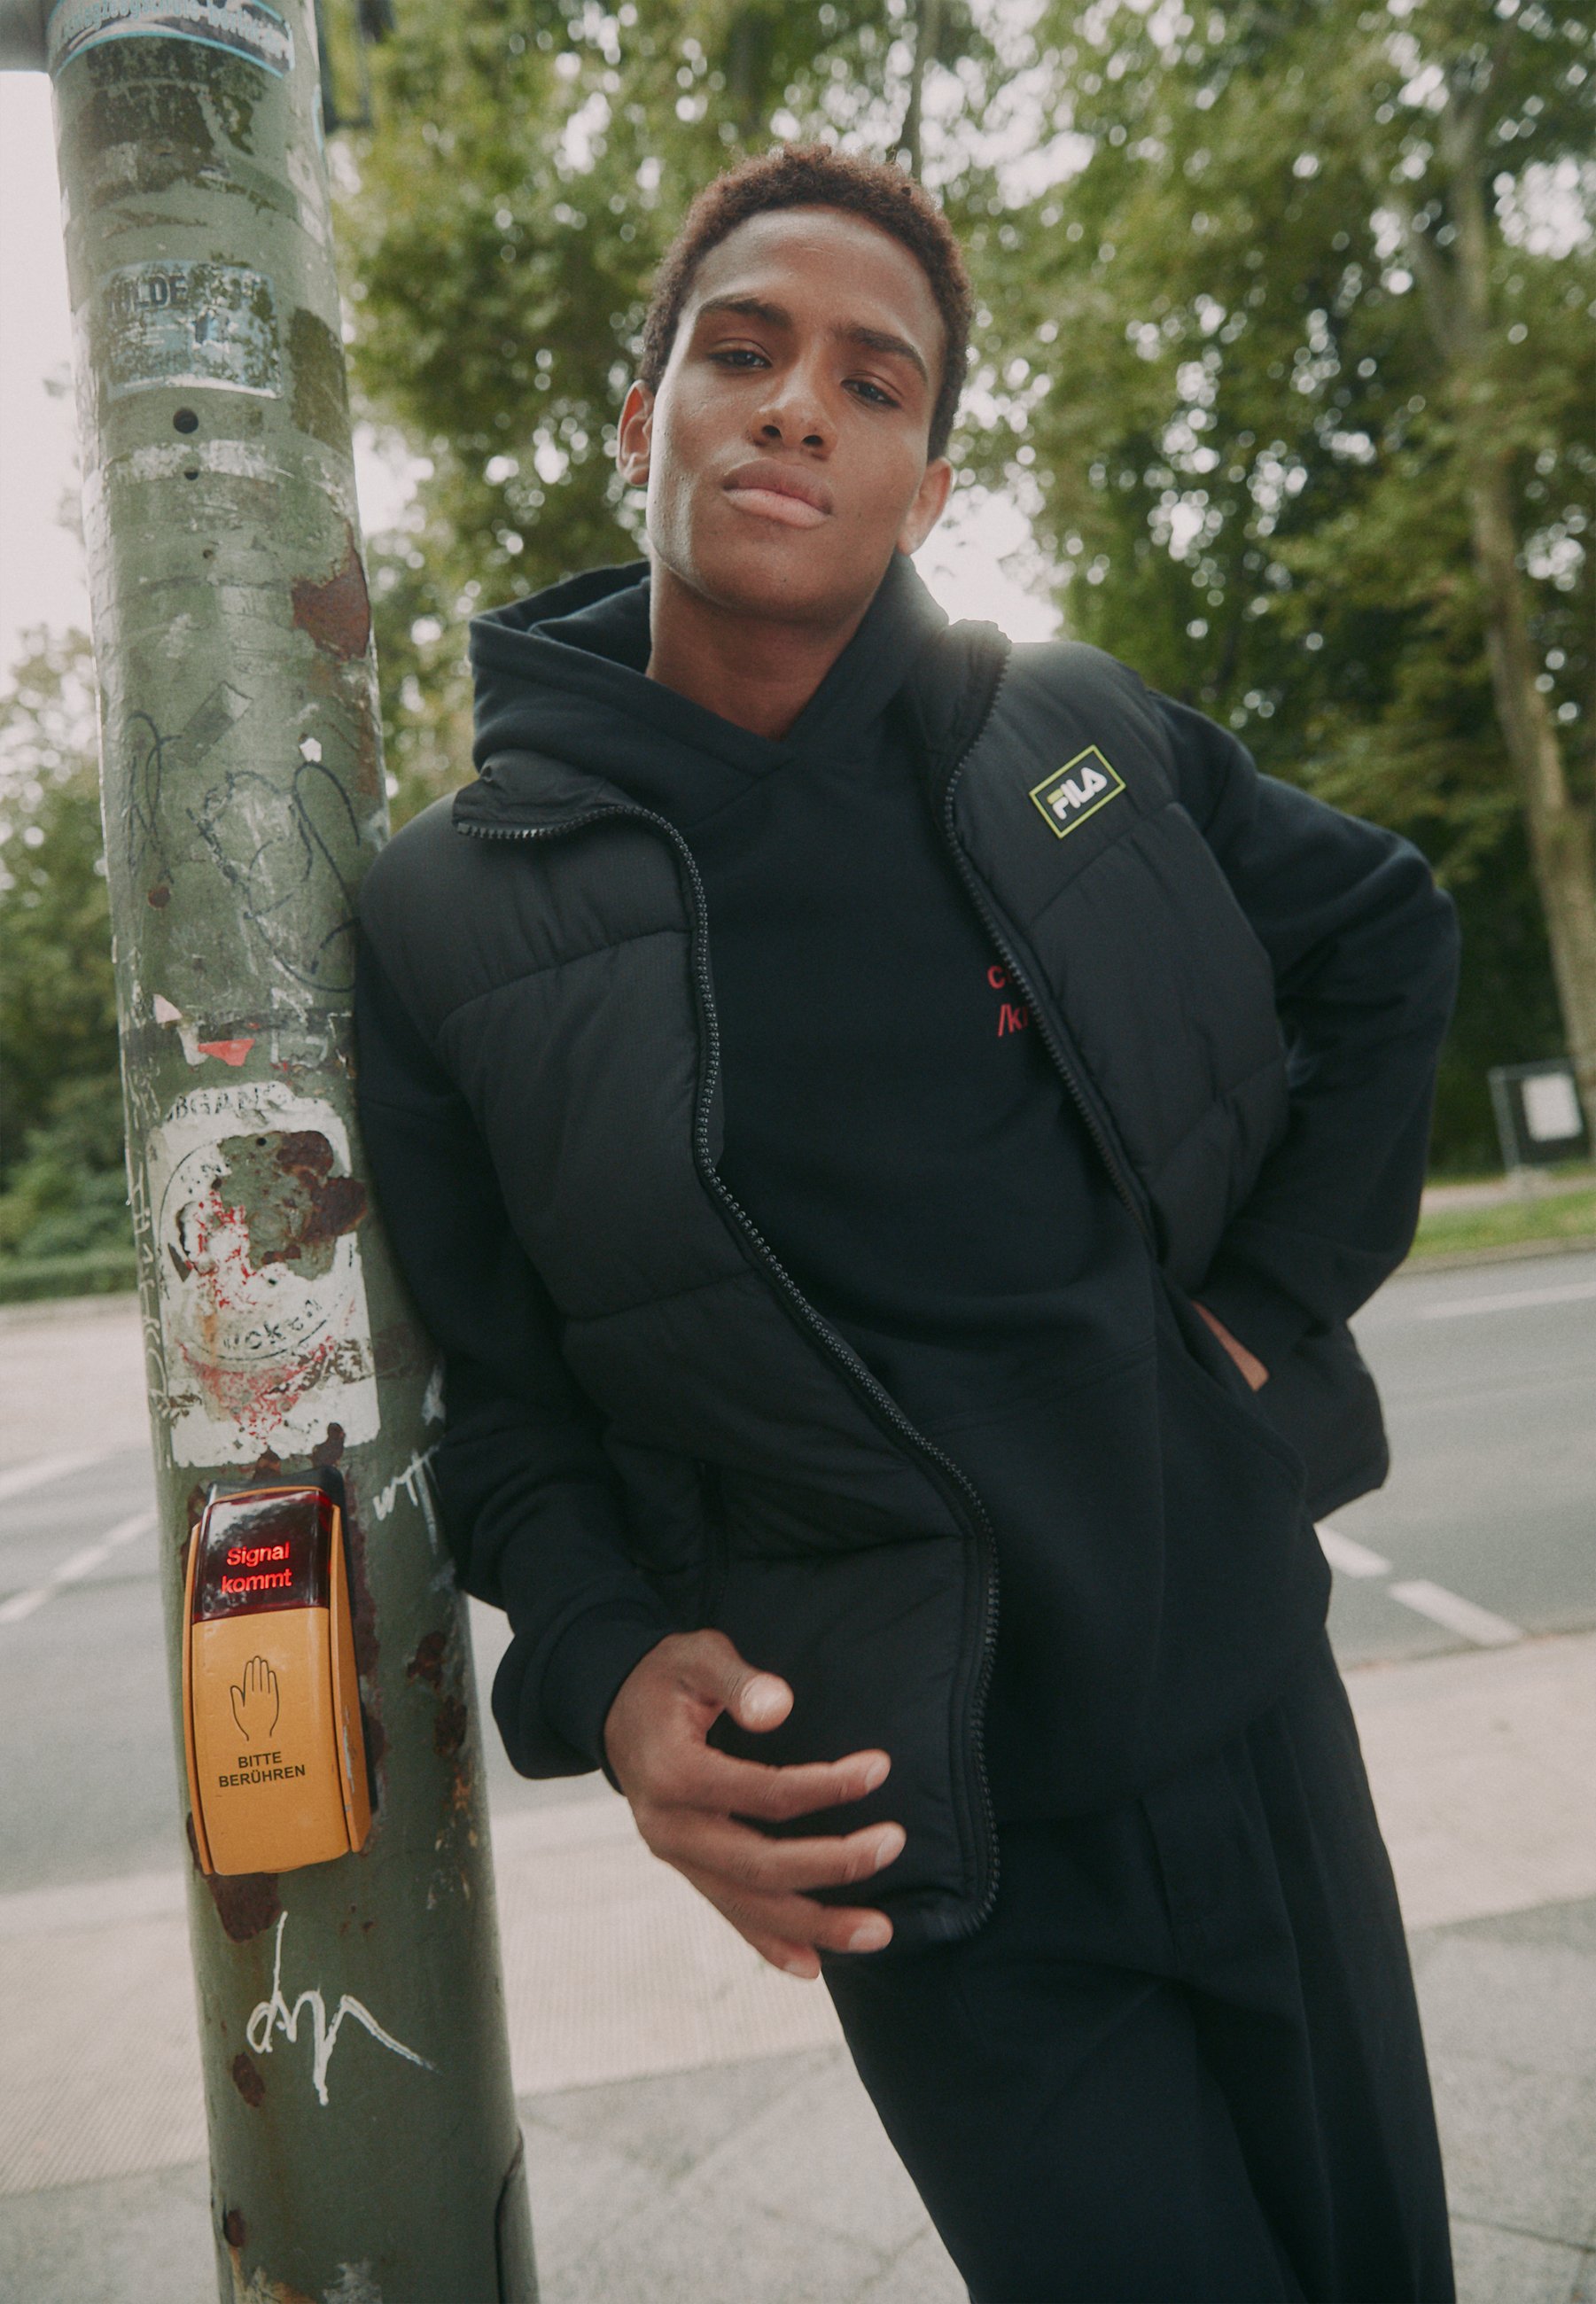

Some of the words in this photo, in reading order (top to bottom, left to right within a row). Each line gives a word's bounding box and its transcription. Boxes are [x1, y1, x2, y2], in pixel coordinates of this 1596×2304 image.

[1047, 767, 1108, 820] FILA
[998, 1003, 1028, 1039] /k
[227, 1541, 290, 1567] Signal
[221, 1568, 292, 1594] kommt
[238, 1751, 282, 1768] BITTE
[219, 1764, 306, 1787] BERÜHREN
